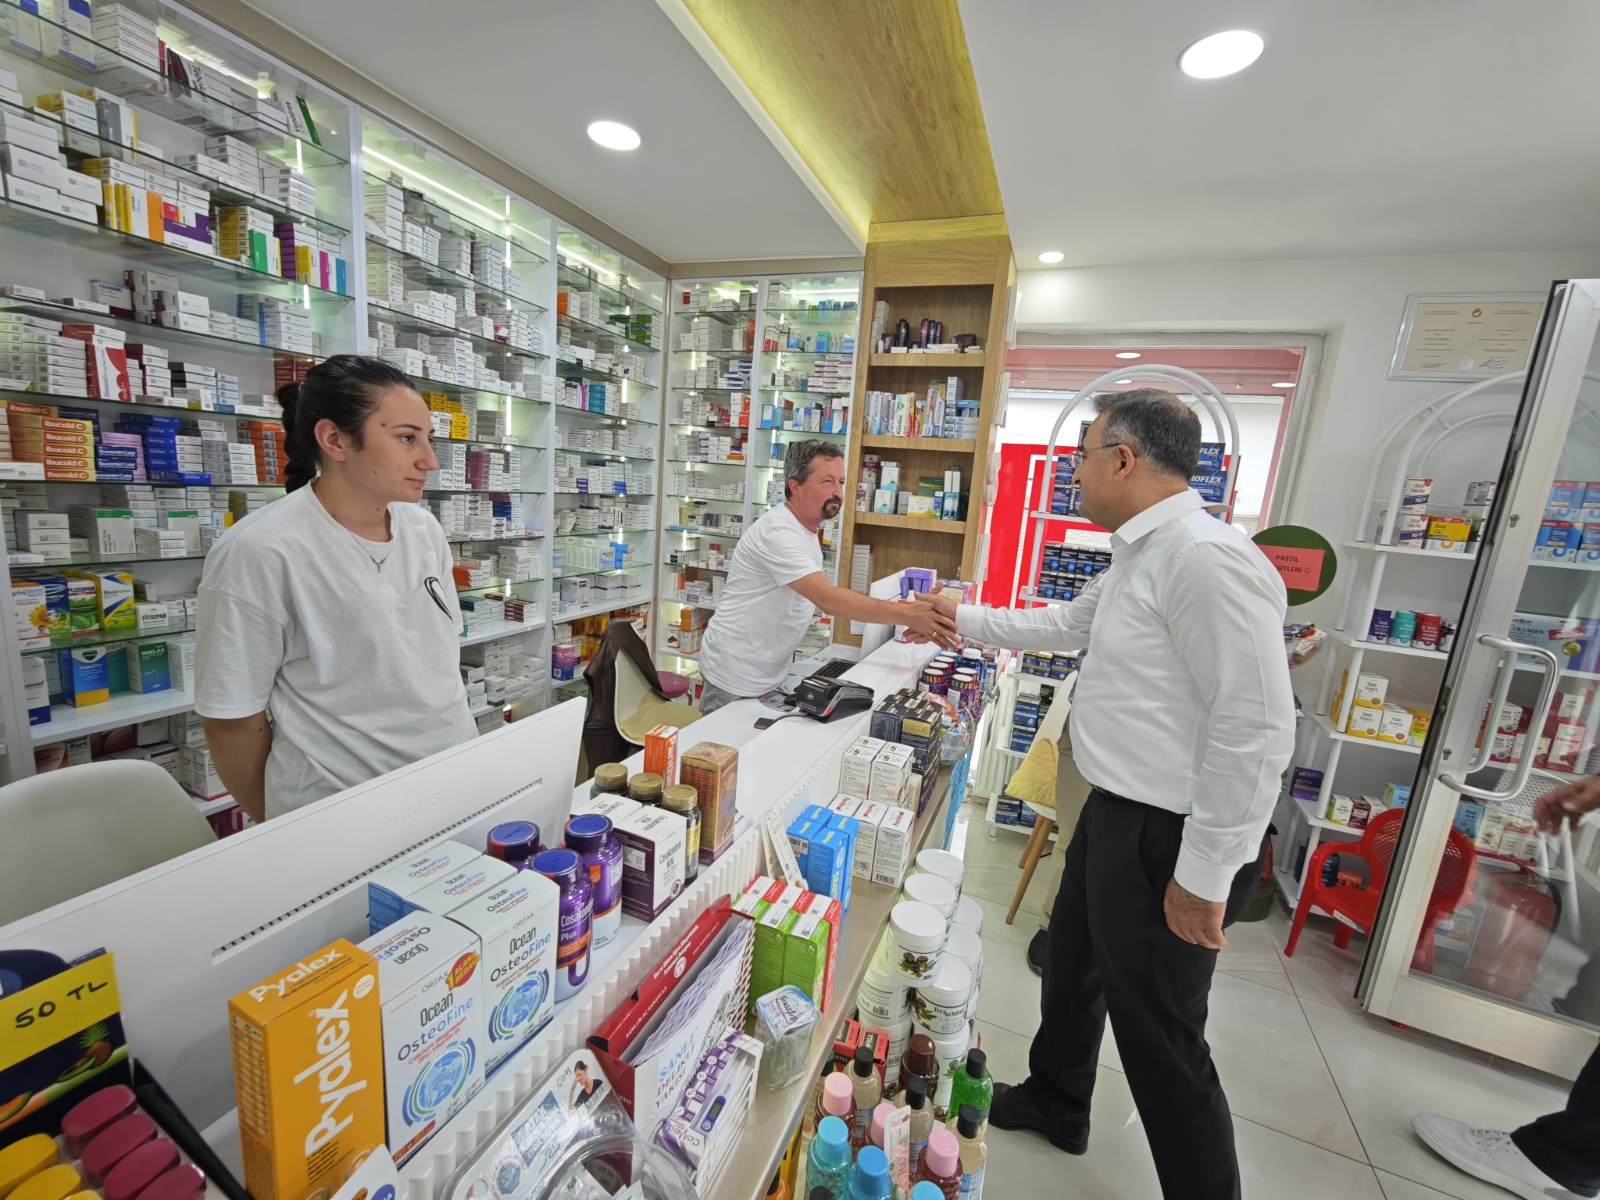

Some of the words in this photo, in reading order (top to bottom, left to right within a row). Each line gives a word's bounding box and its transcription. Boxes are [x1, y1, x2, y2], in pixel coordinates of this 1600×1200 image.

[1199, 447, 1220, 455] FLEX
[377, 926, 431, 961] OsteoFi
[510, 927, 537, 955] Ocean
[561, 930, 578, 942] Plus
[393, 943, 429, 965] Ocean
[490, 933, 551, 983] OsteoFine
[248, 949, 344, 1003] Pyalex
[15, 1001, 57, 1029] 50
[66, 981, 108, 1001] TL
[420, 992, 454, 1027] Ocean
[398, 997, 474, 1061] OsteoFine
[294, 989, 367, 1157] Pyalex
